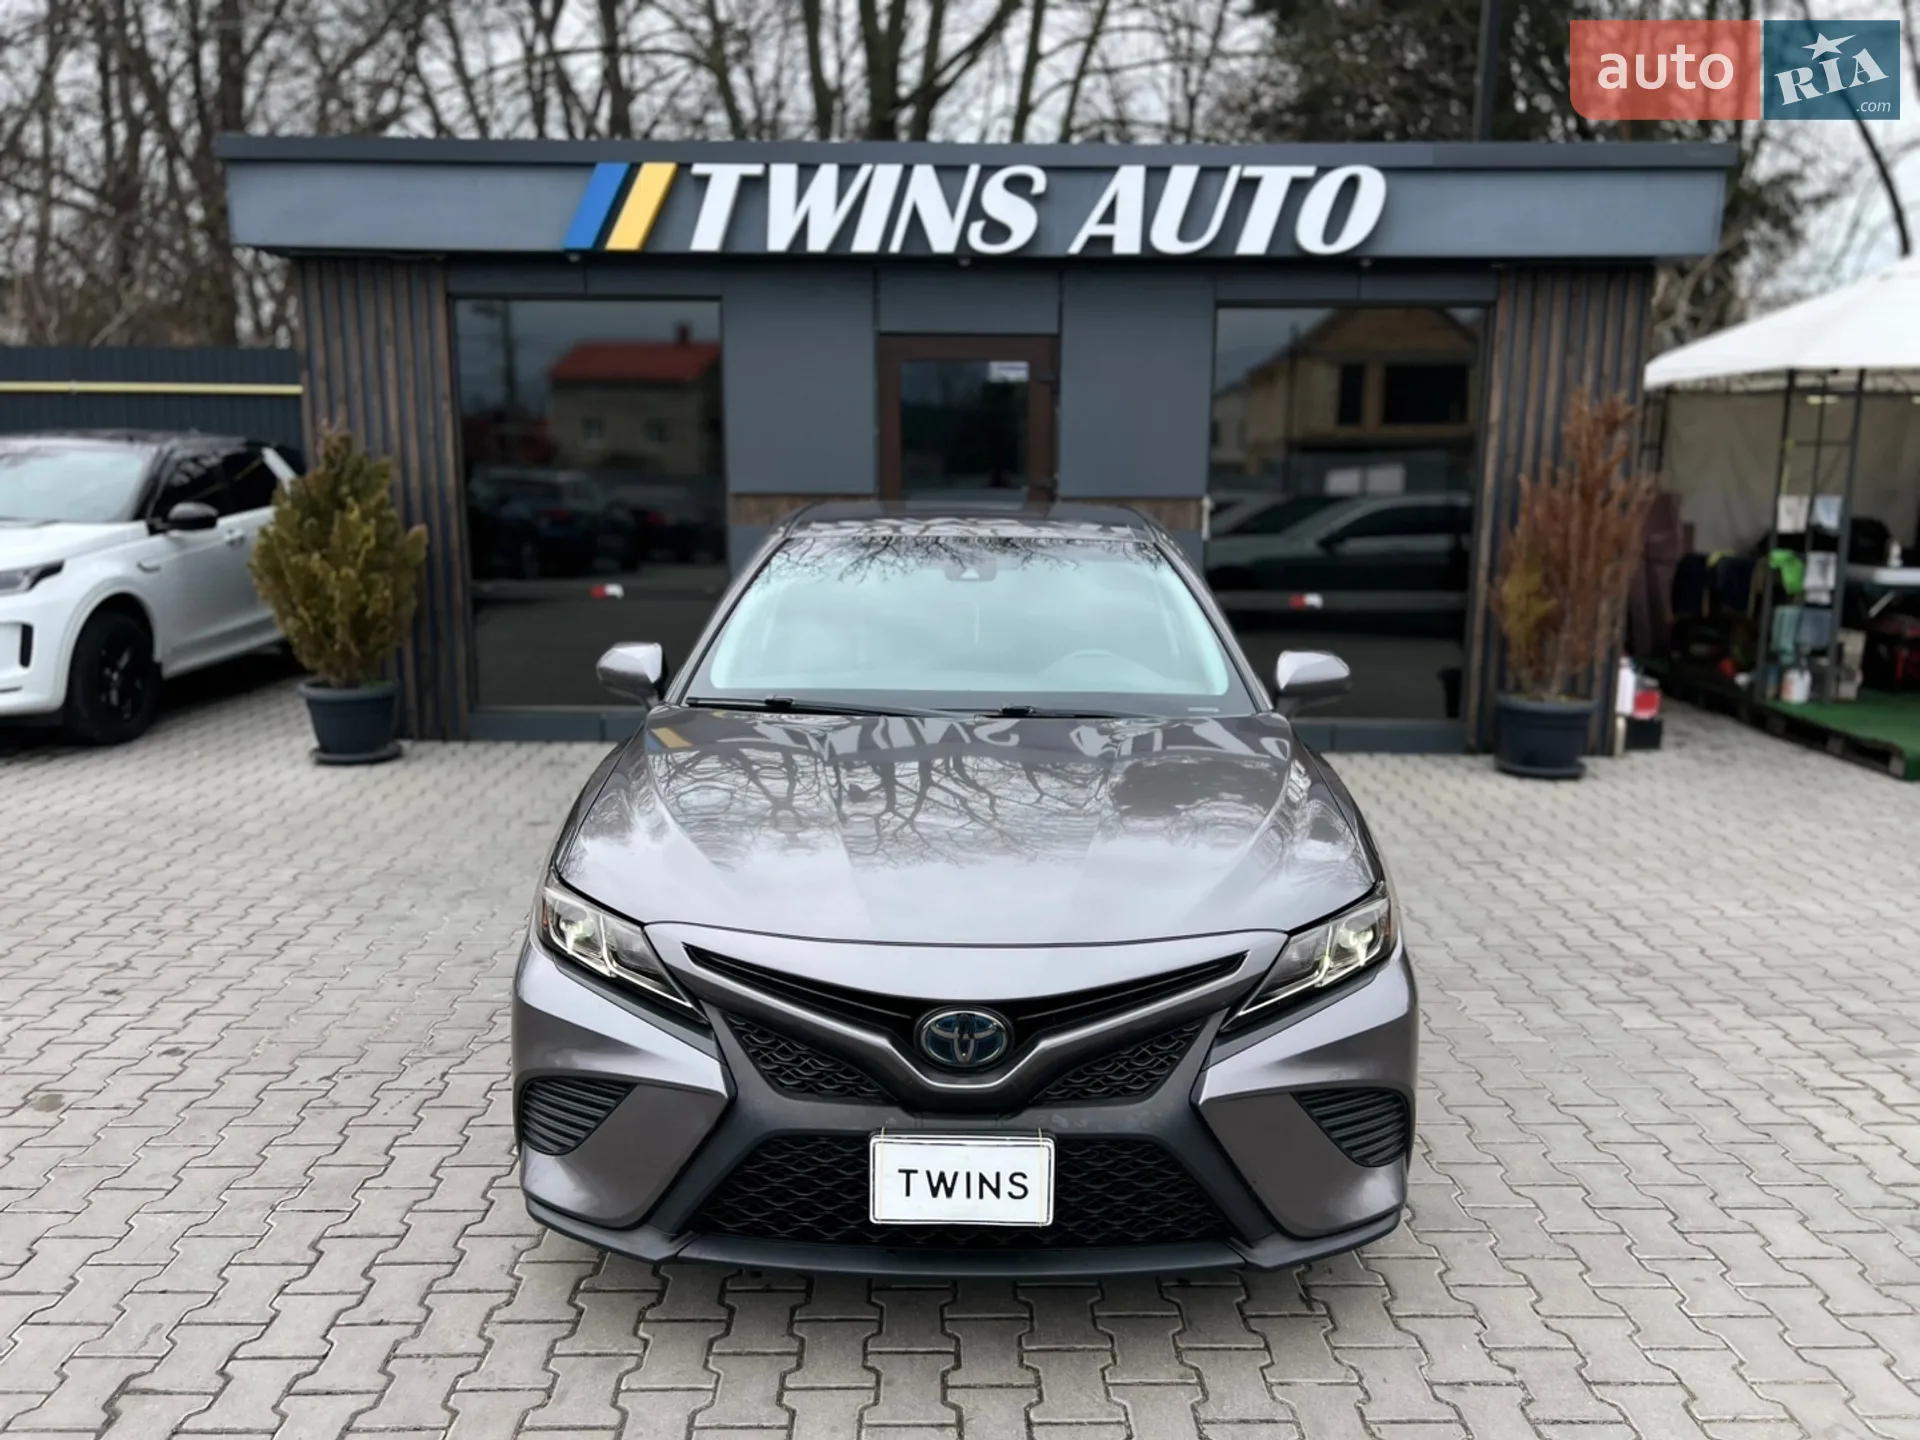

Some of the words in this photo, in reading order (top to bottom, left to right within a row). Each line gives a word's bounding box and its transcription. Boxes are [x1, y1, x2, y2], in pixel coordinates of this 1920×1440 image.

[690, 163, 1048, 254] TWINS
[1067, 164, 1387, 256] AUTO
[898, 1168, 1029, 1200] TWINS
